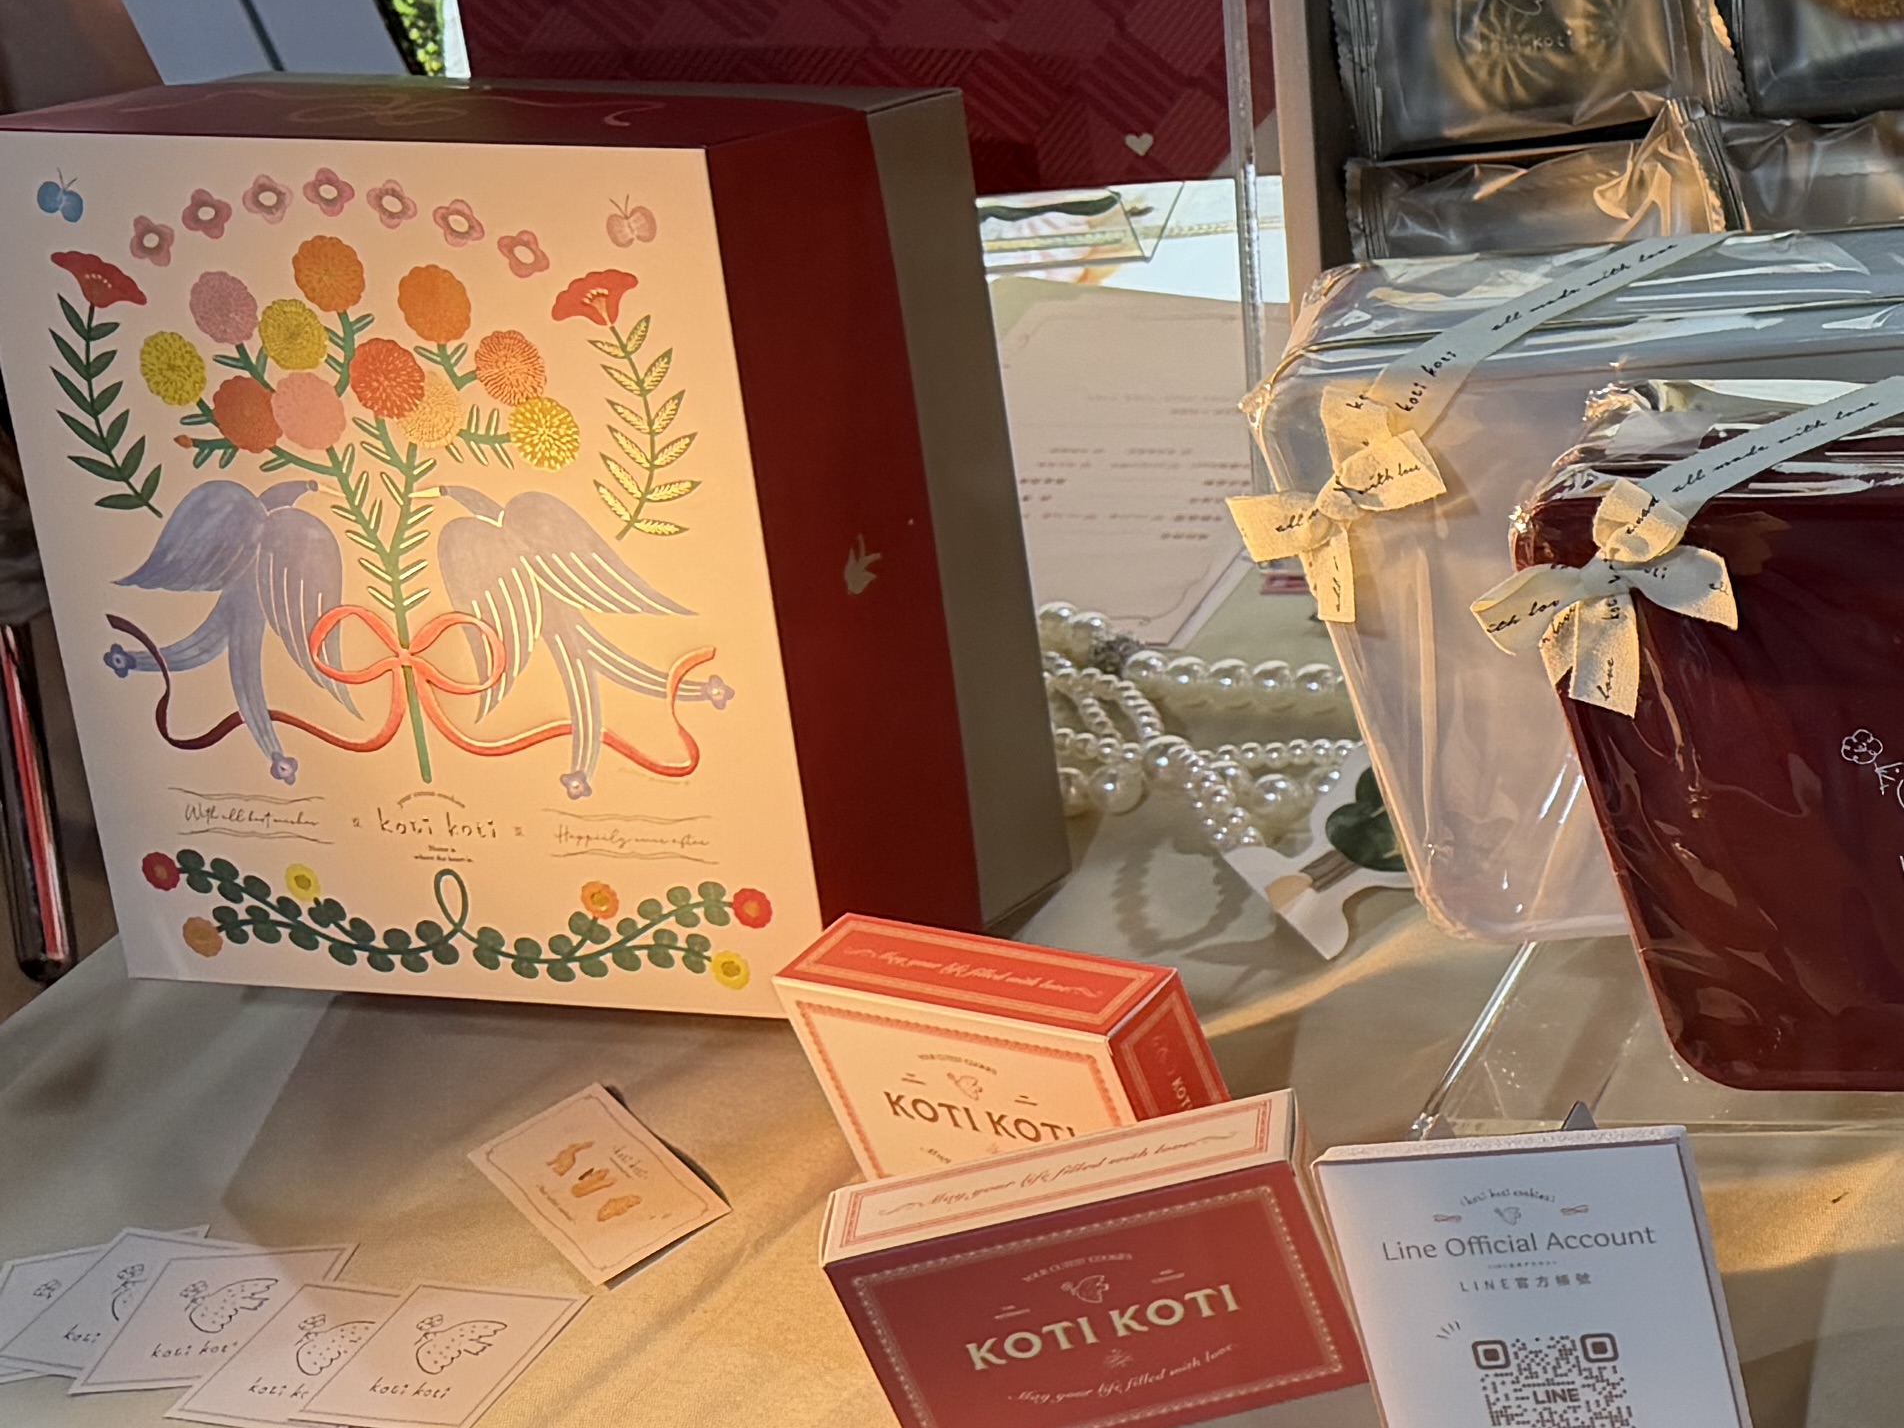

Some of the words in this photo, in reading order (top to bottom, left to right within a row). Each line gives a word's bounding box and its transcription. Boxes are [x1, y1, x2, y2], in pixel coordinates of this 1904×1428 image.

[1491, 310, 1523, 332] all
[1529, 287, 1581, 313] made
[1586, 262, 1632, 288] with
[1638, 243, 1679, 263] love
[1394, 381, 1428, 413] koti
[1421, 349, 1457, 378] koti
[1672, 469, 1706, 493] all
[1713, 444, 1770, 472] made
[1778, 420, 1828, 444] with
[1835, 401, 1880, 420] love
[184, 803, 220, 824] With
[377, 806, 433, 835] koti
[446, 811, 497, 839] koti
[555, 824, 632, 849] Happily
[883, 1090, 979, 1133] KOTI
[1382, 1240, 1437, 1262] Line
[1445, 1232, 1538, 1258] Official
[1546, 1225, 1657, 1252] Account
[965, 1316, 1100, 1371] KOTI
[1108, 1283, 1240, 1338] KOTI
[150, 1342, 192, 1359] koti
[247, 1376, 287, 1397] koti
[368, 1376, 409, 1396] koti
[411, 1379, 452, 1400] koti
[1051, 1387, 1094, 1404] your
[1124, 1368, 1166, 1395] filled
[1169, 1357, 1201, 1377] with
[1531, 1386, 1581, 1406] LINE
